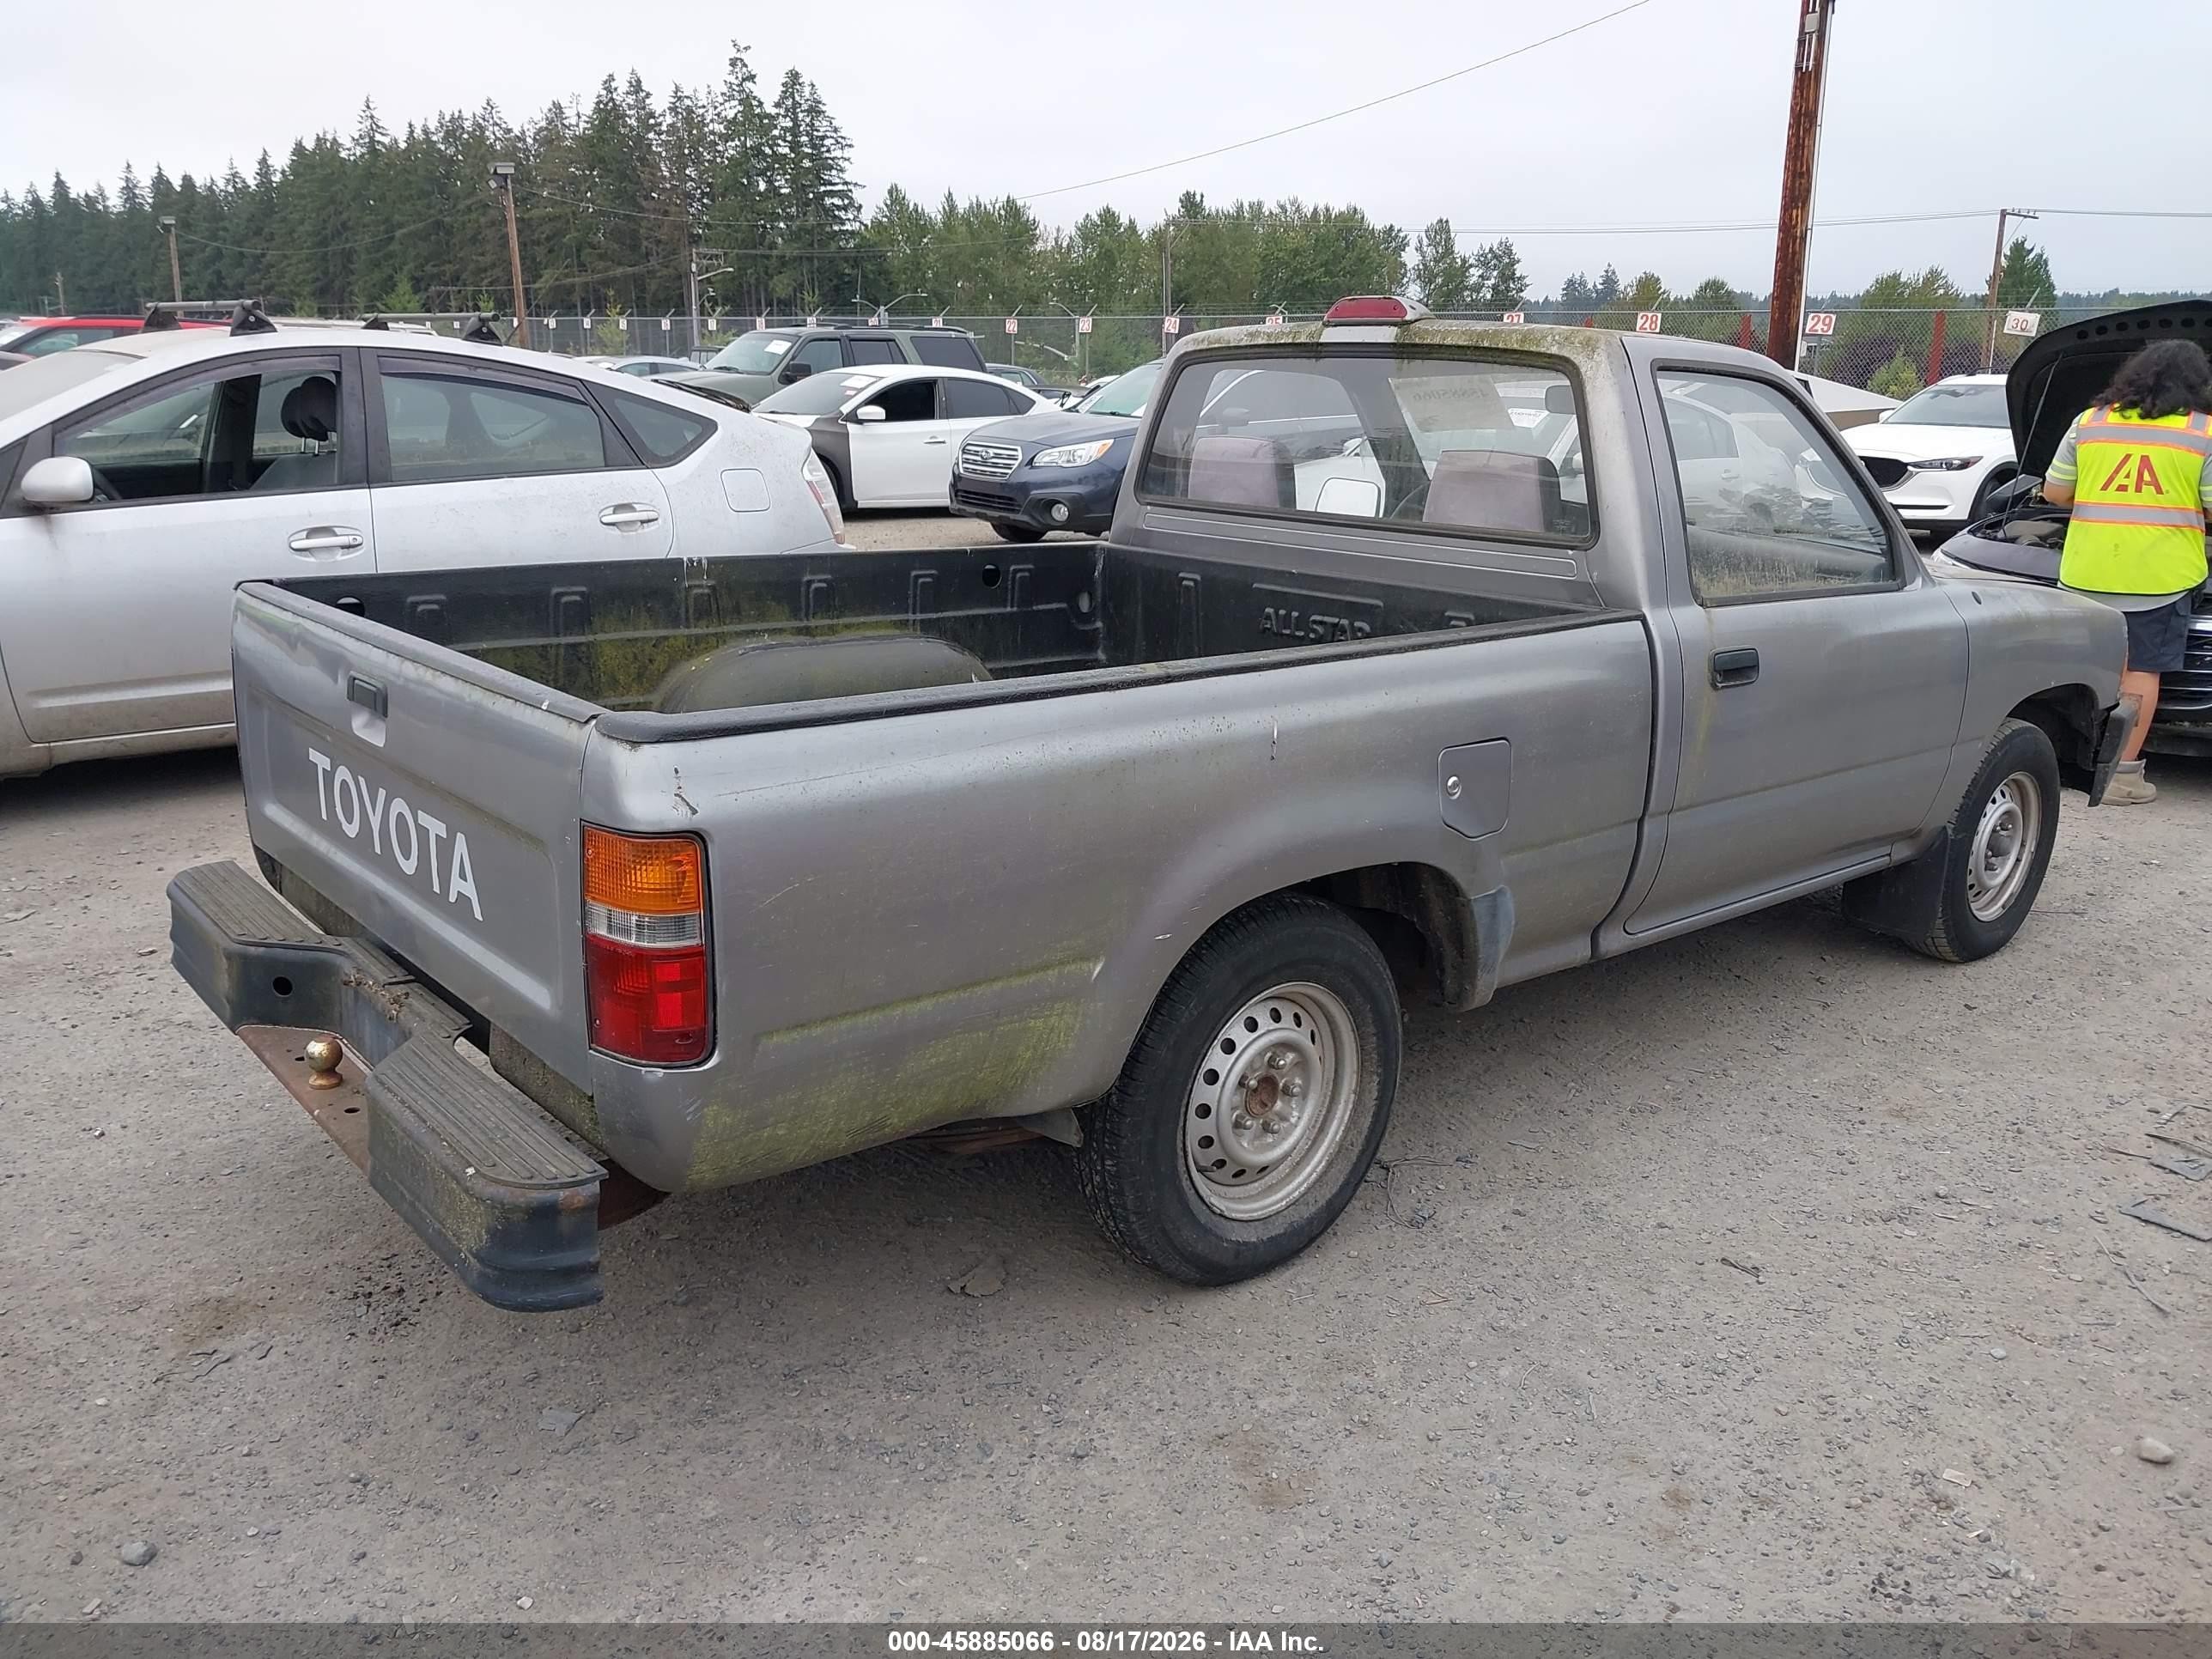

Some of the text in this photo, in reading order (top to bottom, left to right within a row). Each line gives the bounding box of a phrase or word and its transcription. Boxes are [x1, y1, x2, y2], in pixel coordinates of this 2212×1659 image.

[1006, 320, 1017, 332] 22
[1080, 319, 1091, 331] 23
[1165, 319, 1177, 332] 24
[1638, 314, 1658, 331] 28
[1808, 314, 1834, 333] 29
[2011, 318, 2029, 331] 30
[308, 747, 483, 921] TOYOTA
